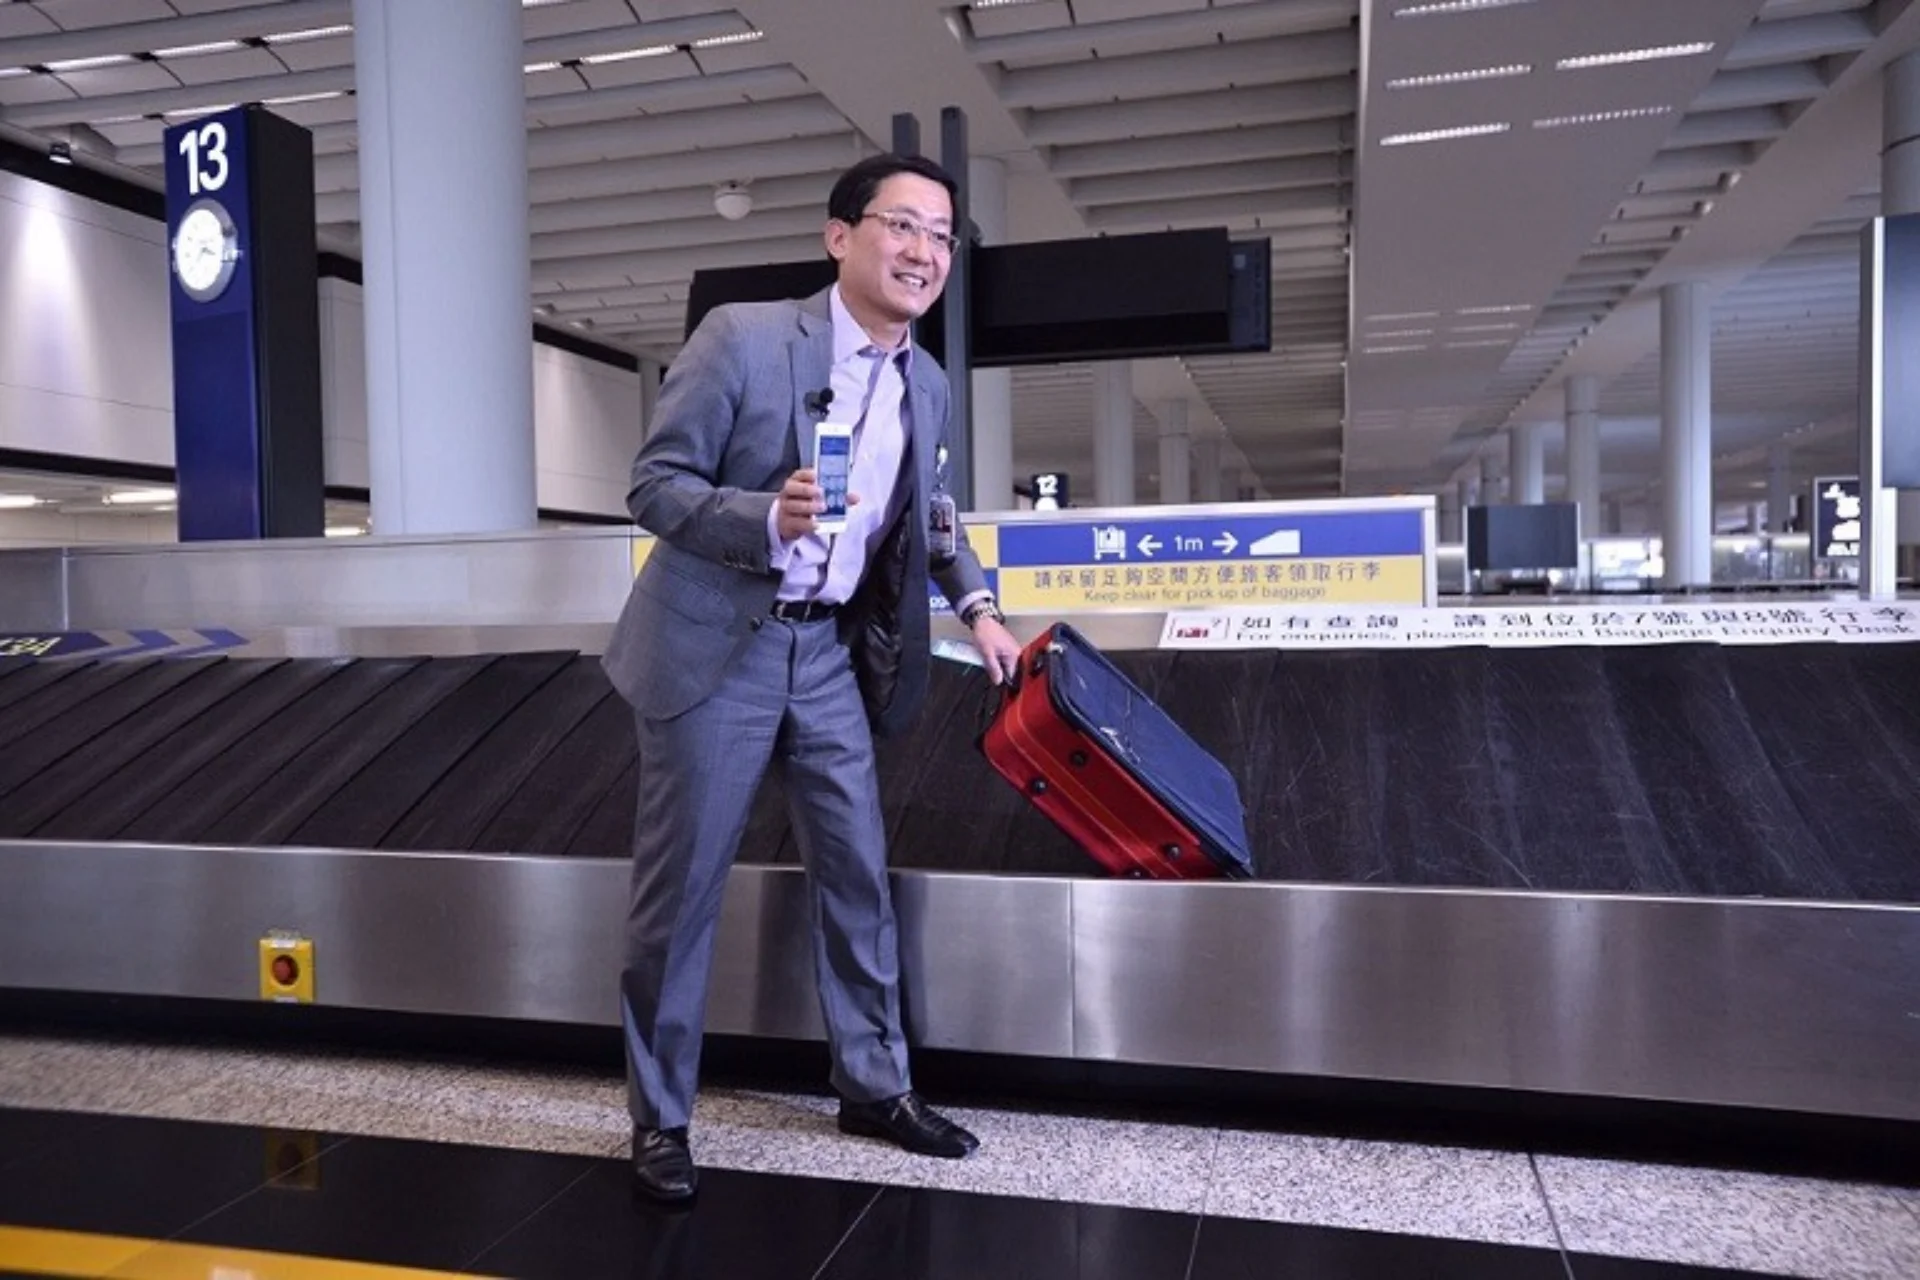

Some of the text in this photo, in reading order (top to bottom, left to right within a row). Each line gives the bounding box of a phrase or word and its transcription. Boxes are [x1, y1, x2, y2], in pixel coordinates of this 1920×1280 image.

[179, 121, 229, 195] 13
[1174, 534, 1204, 552] 1m
[1085, 586, 1327, 603] Keep clear for pick up of baggage
[1236, 632, 1271, 641] For
[1593, 626, 1714, 639] Baggage
